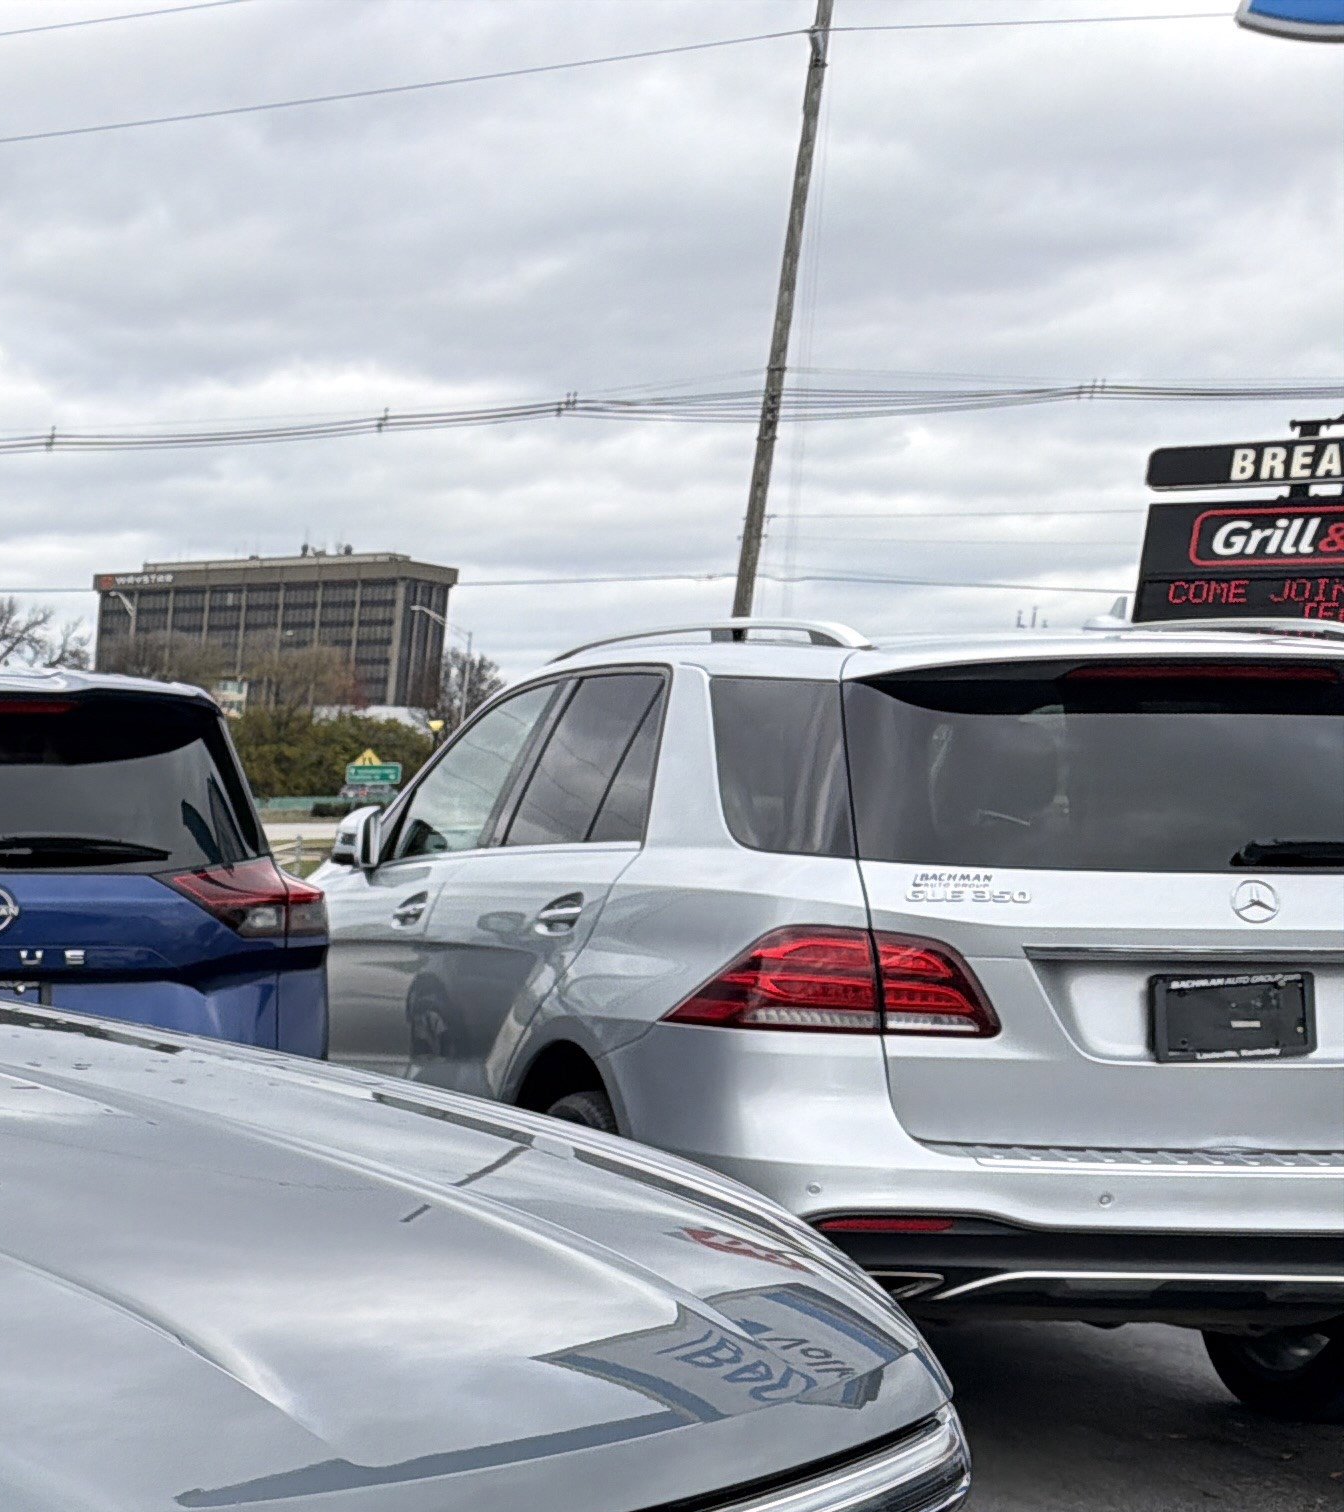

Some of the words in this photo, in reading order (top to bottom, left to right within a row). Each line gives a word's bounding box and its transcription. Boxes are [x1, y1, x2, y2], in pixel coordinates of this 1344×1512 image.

[1230, 443, 1344, 481] BREA
[1212, 517, 1322, 556] Grill
[1168, 580, 1250, 605] COME
[905, 890, 964, 903] GLE
[971, 890, 1032, 904] 350
